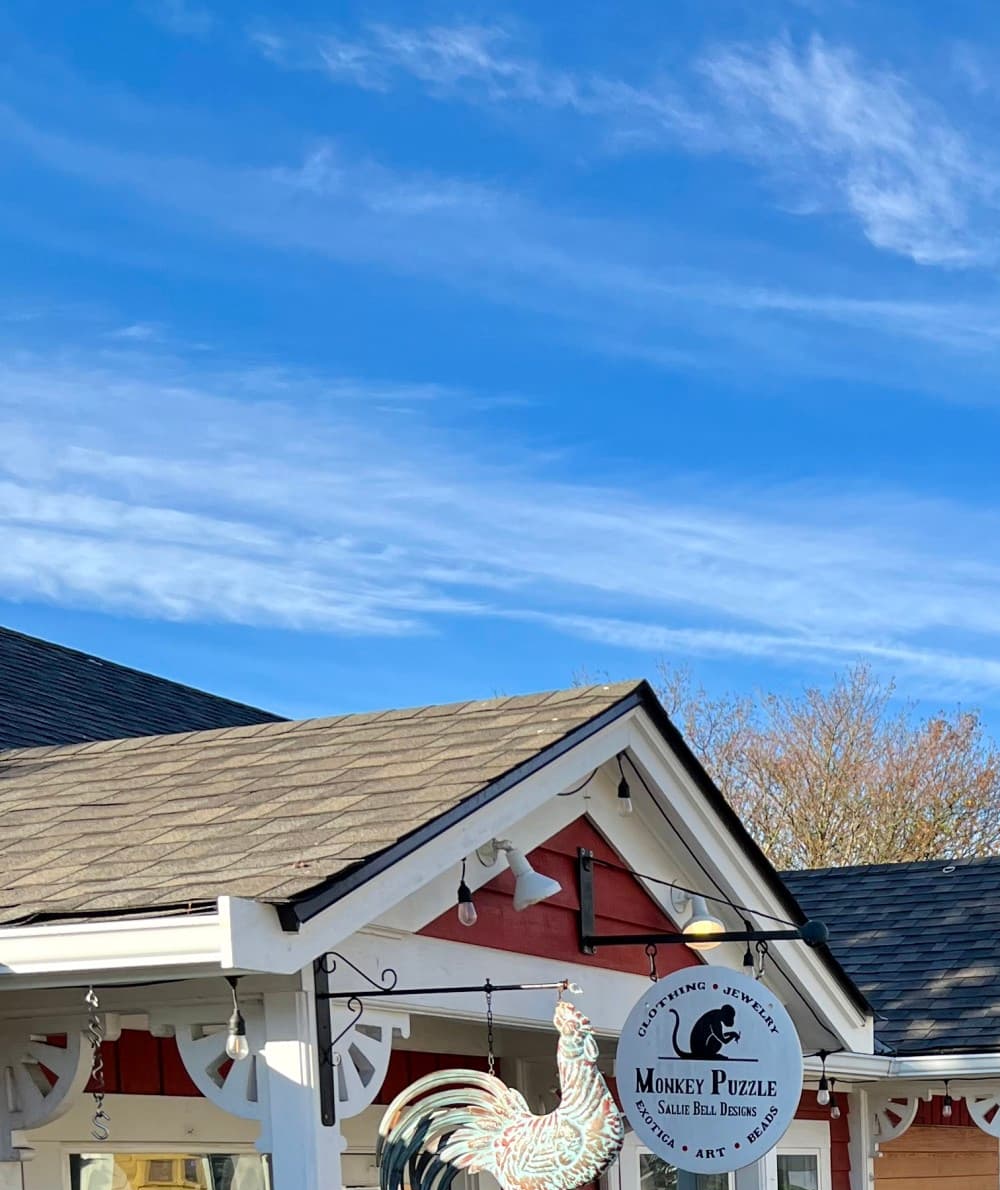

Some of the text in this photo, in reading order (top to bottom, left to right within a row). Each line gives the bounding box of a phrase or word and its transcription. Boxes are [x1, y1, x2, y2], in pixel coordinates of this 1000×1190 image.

[638, 981, 780, 1038] CLOTHING JEWELRY
[635, 1067, 777, 1097] MONKEY PUZZLE
[635, 1099, 778, 1159] EXOTICA ART BEADS
[658, 1100, 757, 1117] SALLIE BELL DESIGNS
